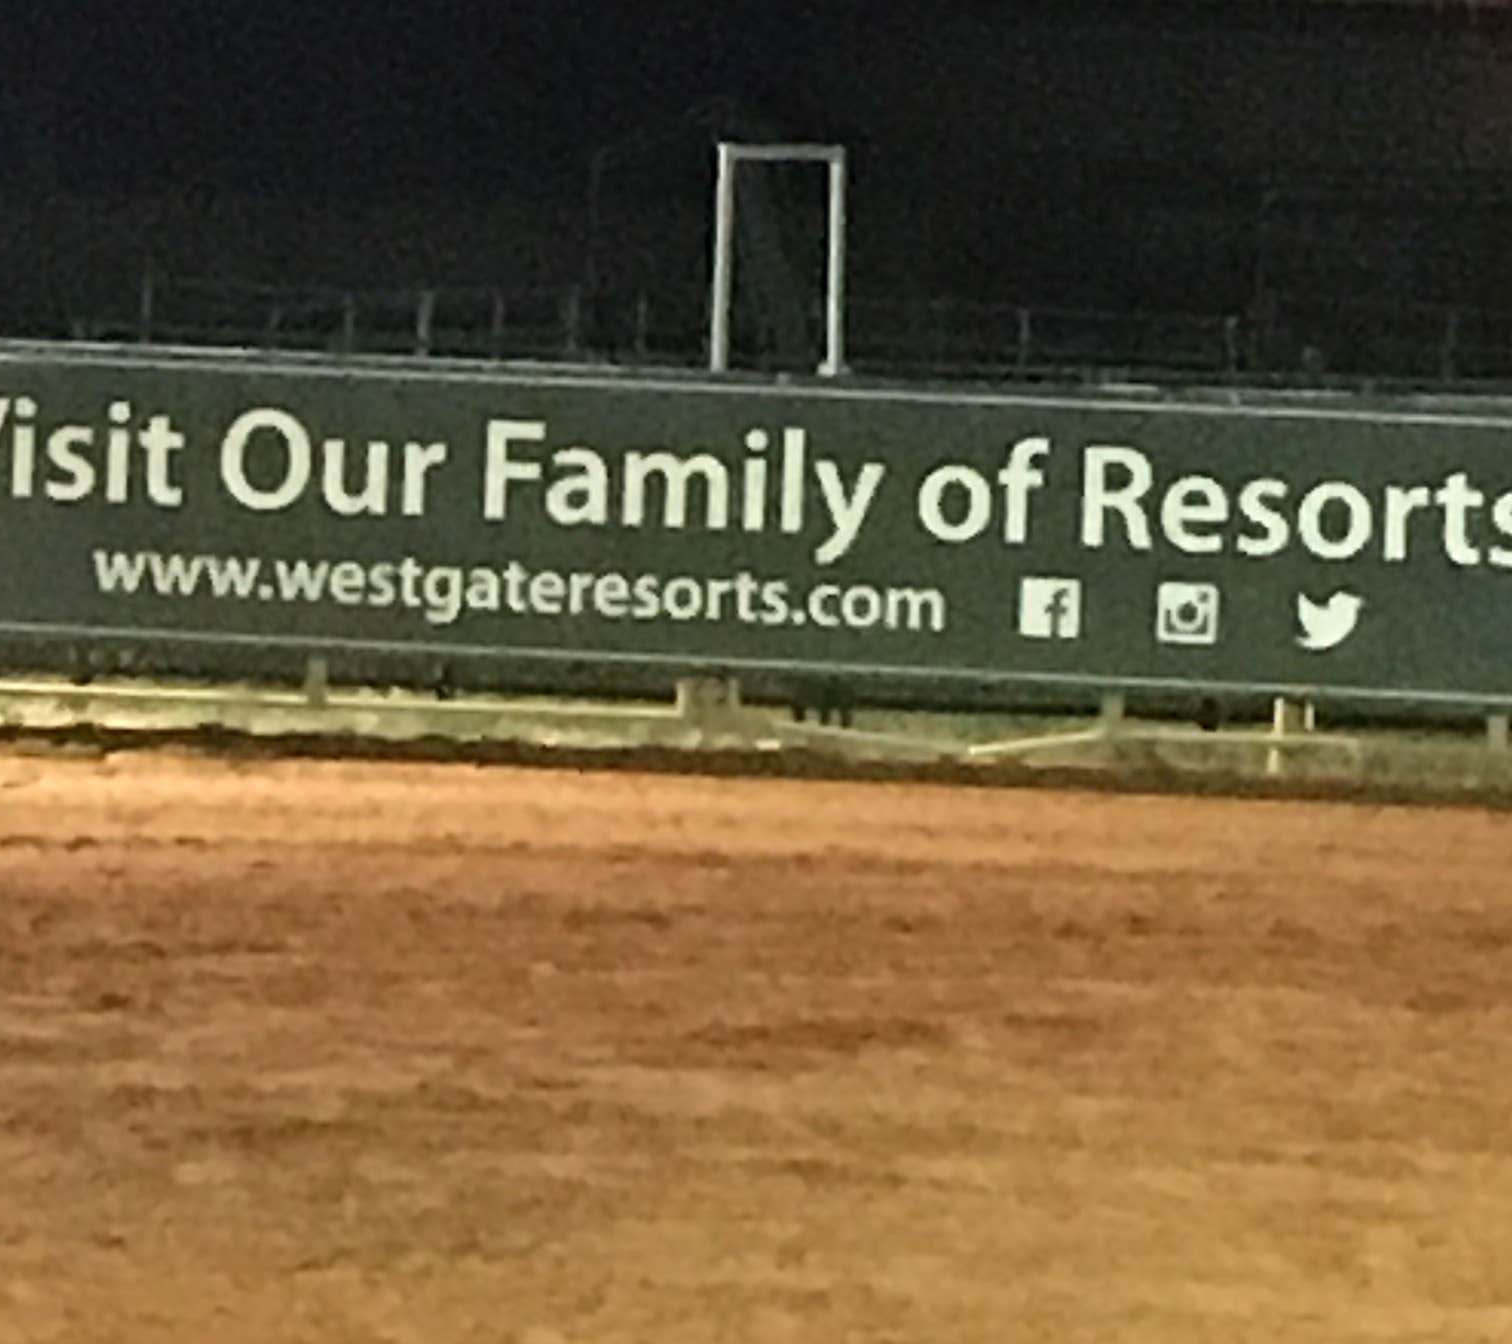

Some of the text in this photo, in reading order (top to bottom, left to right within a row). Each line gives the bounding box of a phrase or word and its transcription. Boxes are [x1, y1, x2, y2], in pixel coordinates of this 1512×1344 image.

[219, 407, 447, 517] Our
[483, 418, 885, 565] Family
[917, 436, 1050, 544] of
[92, 549, 945, 632] www.westgateresorts.com
